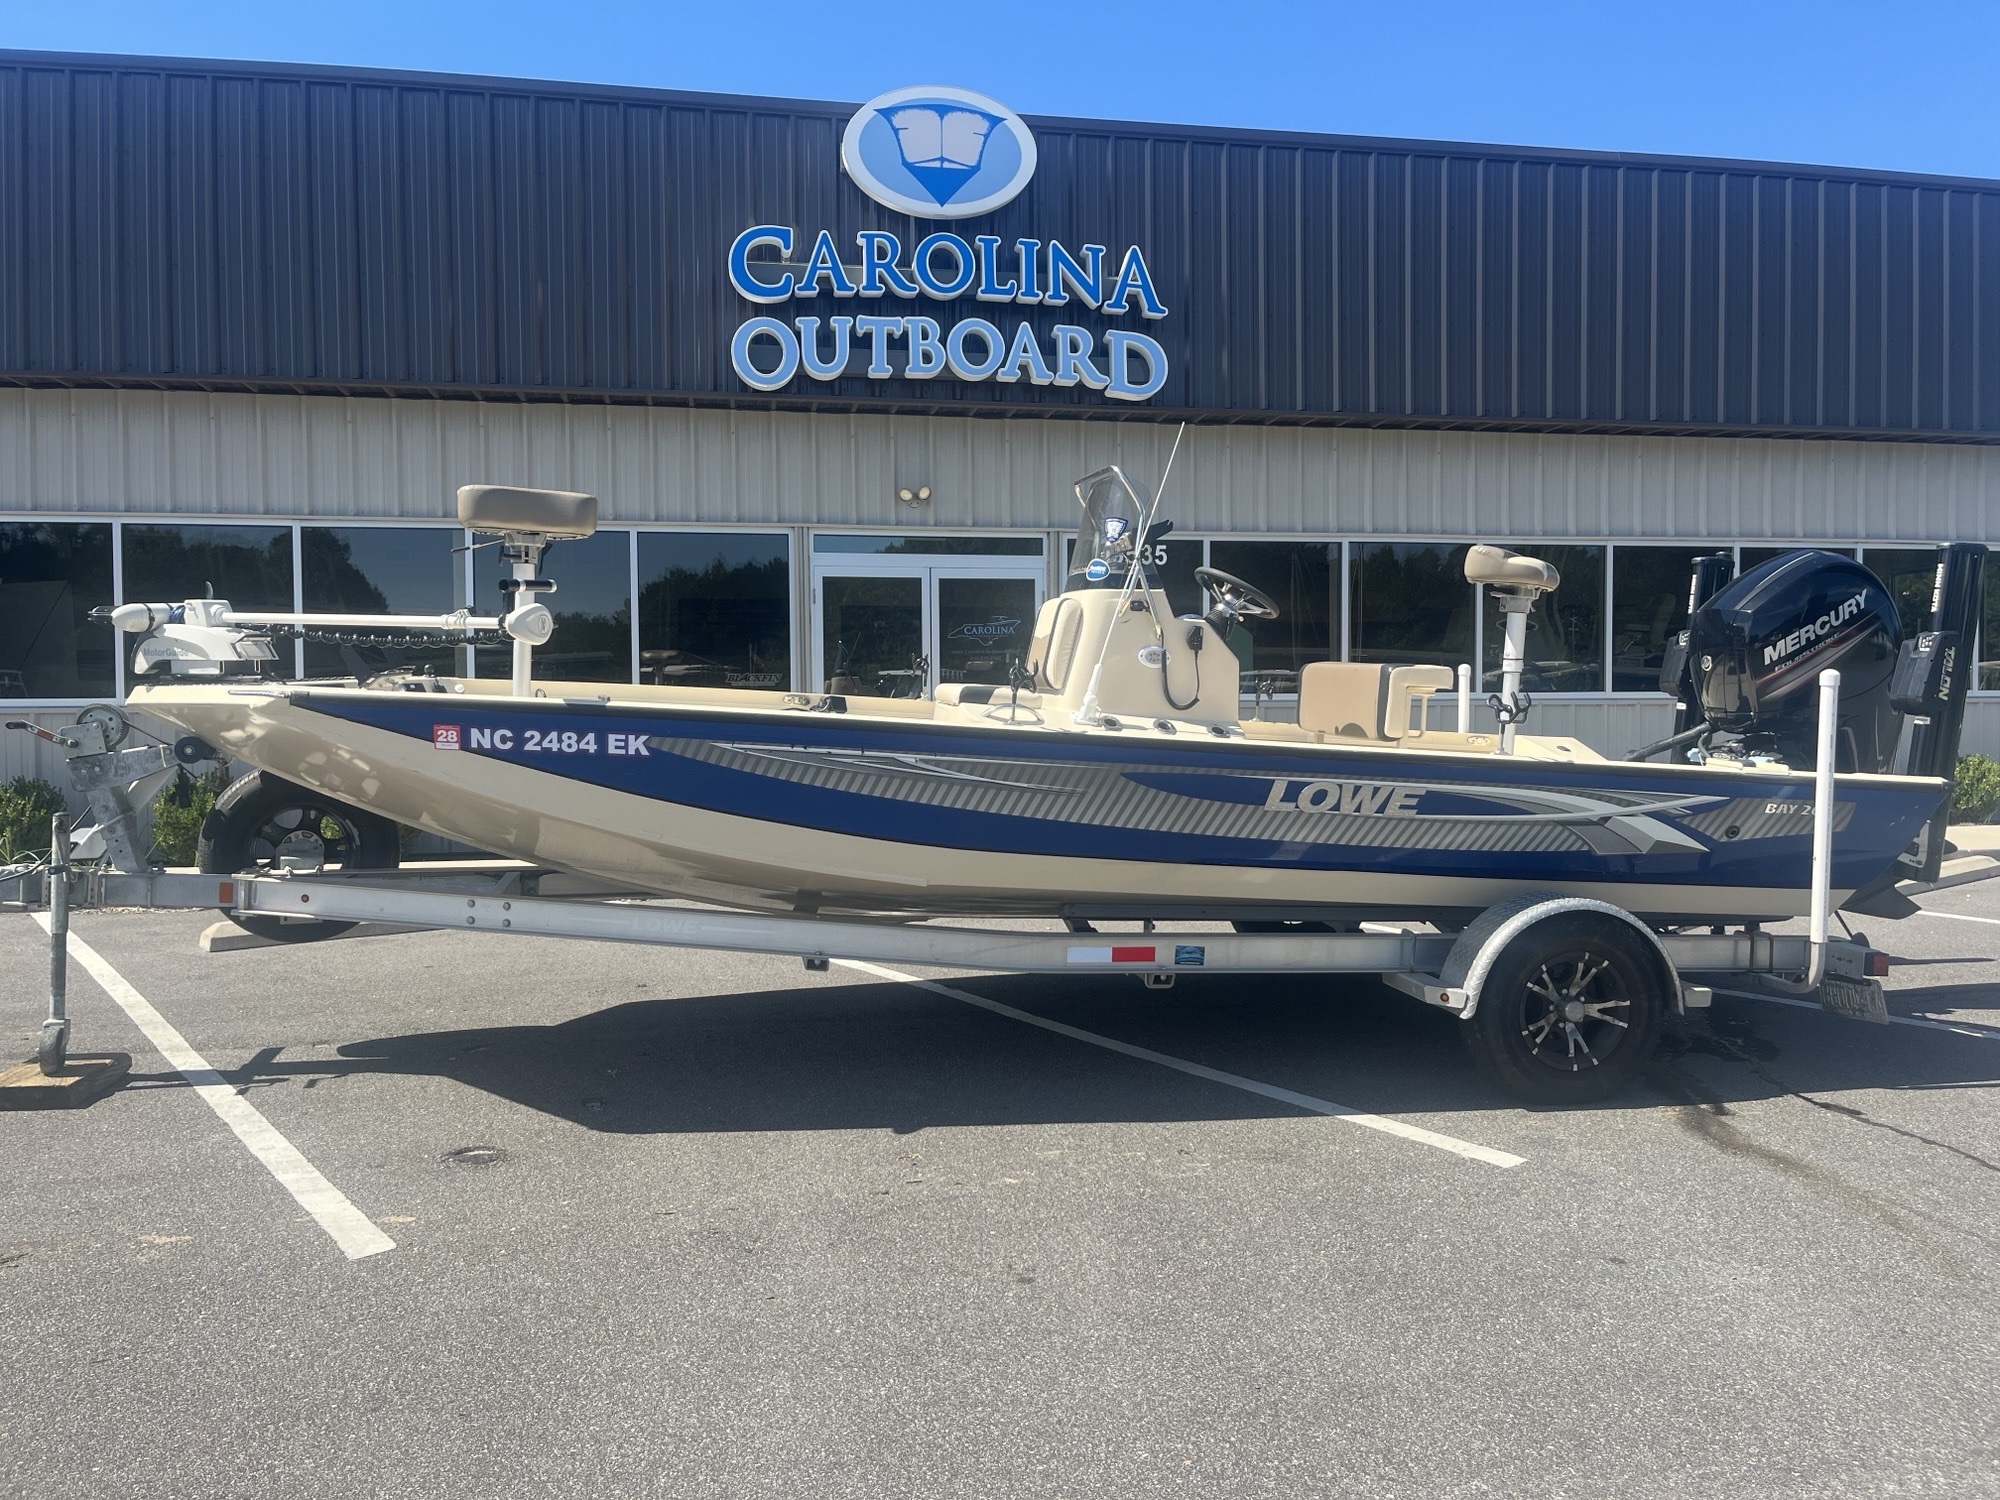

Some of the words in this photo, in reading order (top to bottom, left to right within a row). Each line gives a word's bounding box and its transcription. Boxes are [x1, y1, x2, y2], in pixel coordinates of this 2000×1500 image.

[728, 225, 1168, 319] CAROLINA
[731, 315, 1168, 401] OUTBOARD
[963, 626, 1015, 635] CAROLINA
[1763, 588, 1867, 666] MERCURY
[143, 647, 189, 657] MotorGuide
[1938, 646, 1956, 700] TALON
[437, 729, 458, 742] 28
[470, 728, 514, 750] NC
[523, 730, 598, 754] 2484
[607, 733, 650, 756] EK
[1264, 779, 1428, 818] LOWE
[1764, 803, 1799, 814] BAY
